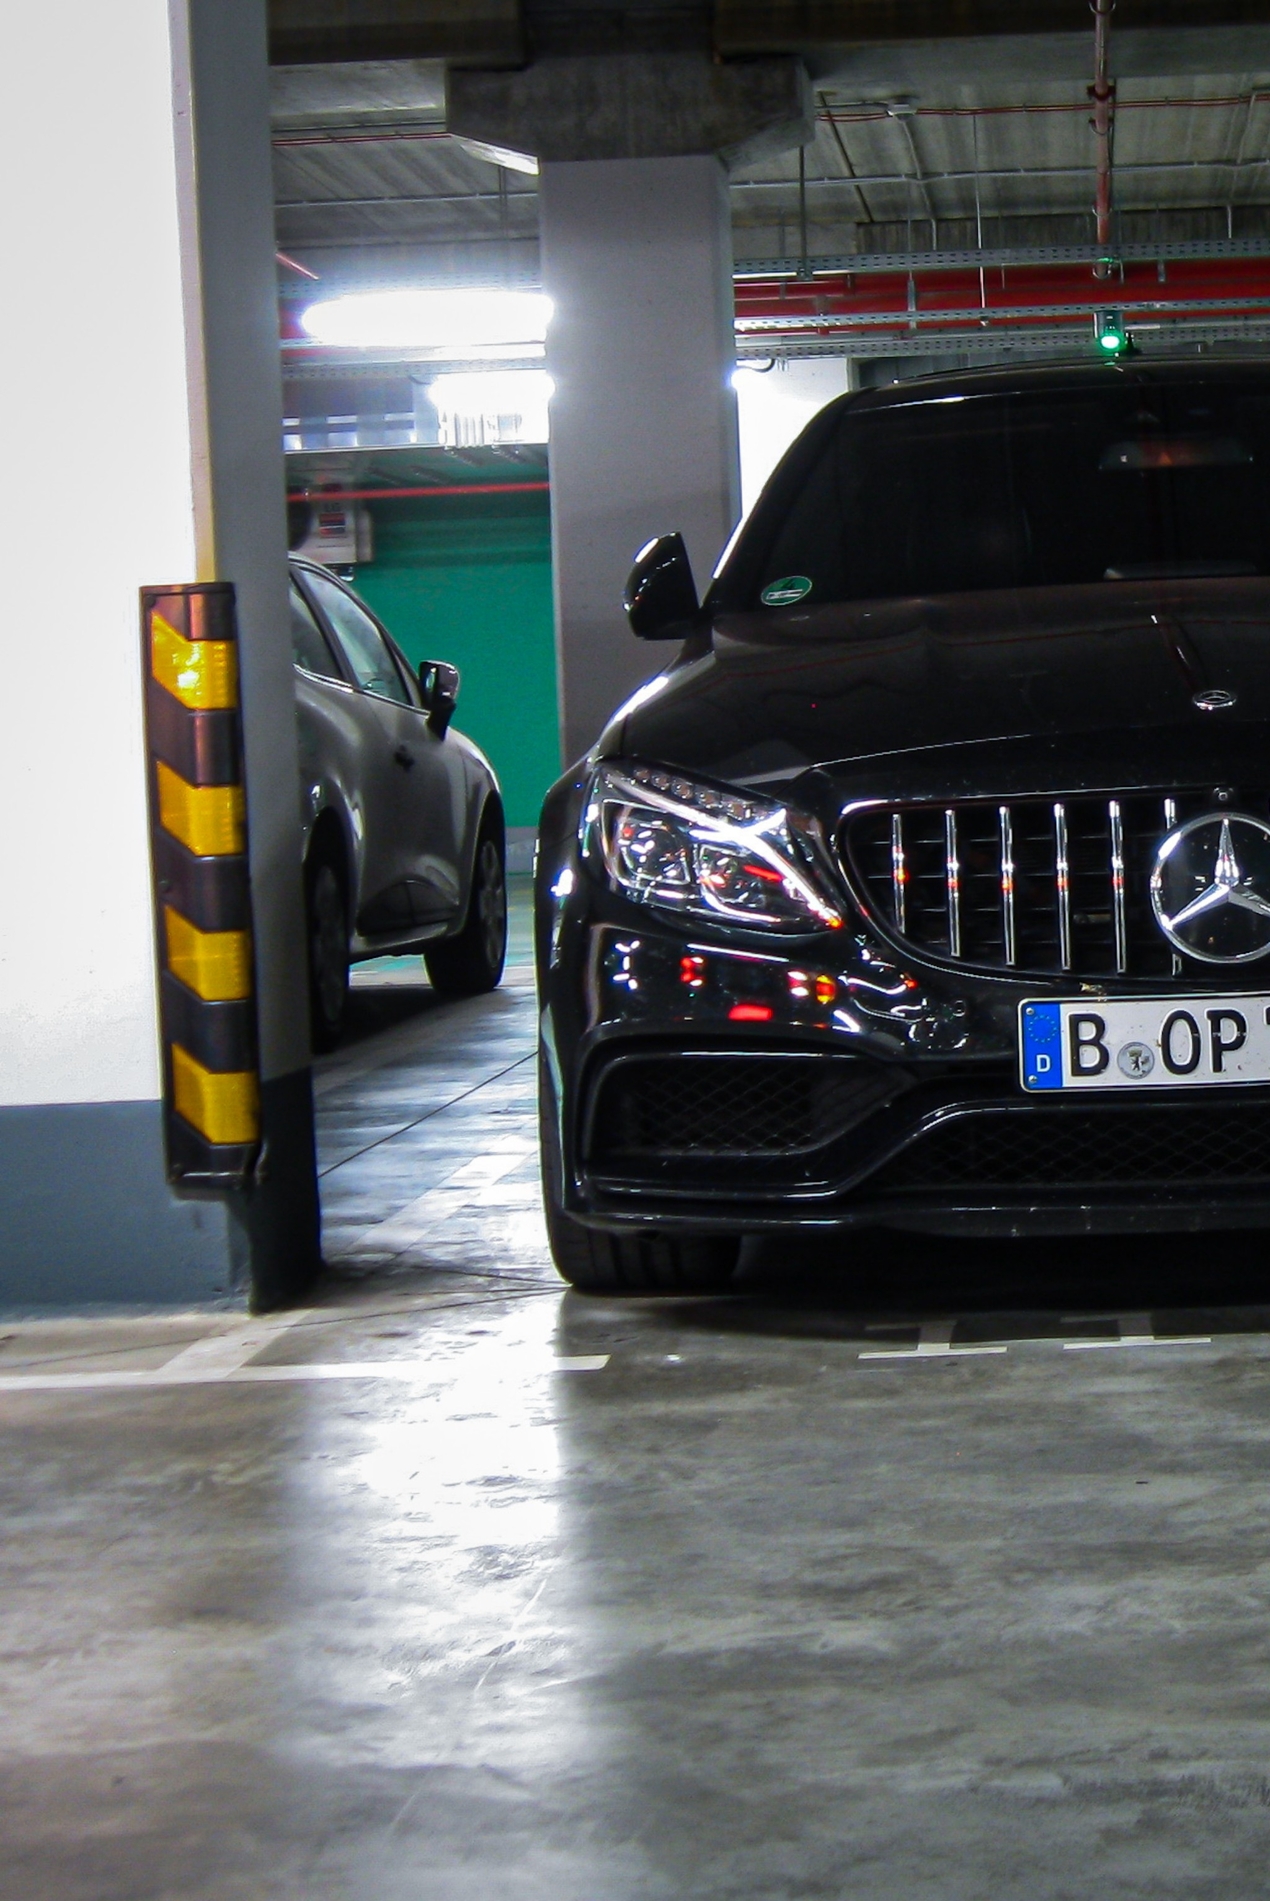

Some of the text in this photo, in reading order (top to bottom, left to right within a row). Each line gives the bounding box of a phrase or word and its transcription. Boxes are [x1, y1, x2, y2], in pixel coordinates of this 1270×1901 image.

[1036, 1054, 1052, 1074] D
[1067, 1013, 1110, 1077] B
[1160, 1008, 1247, 1076] OP
